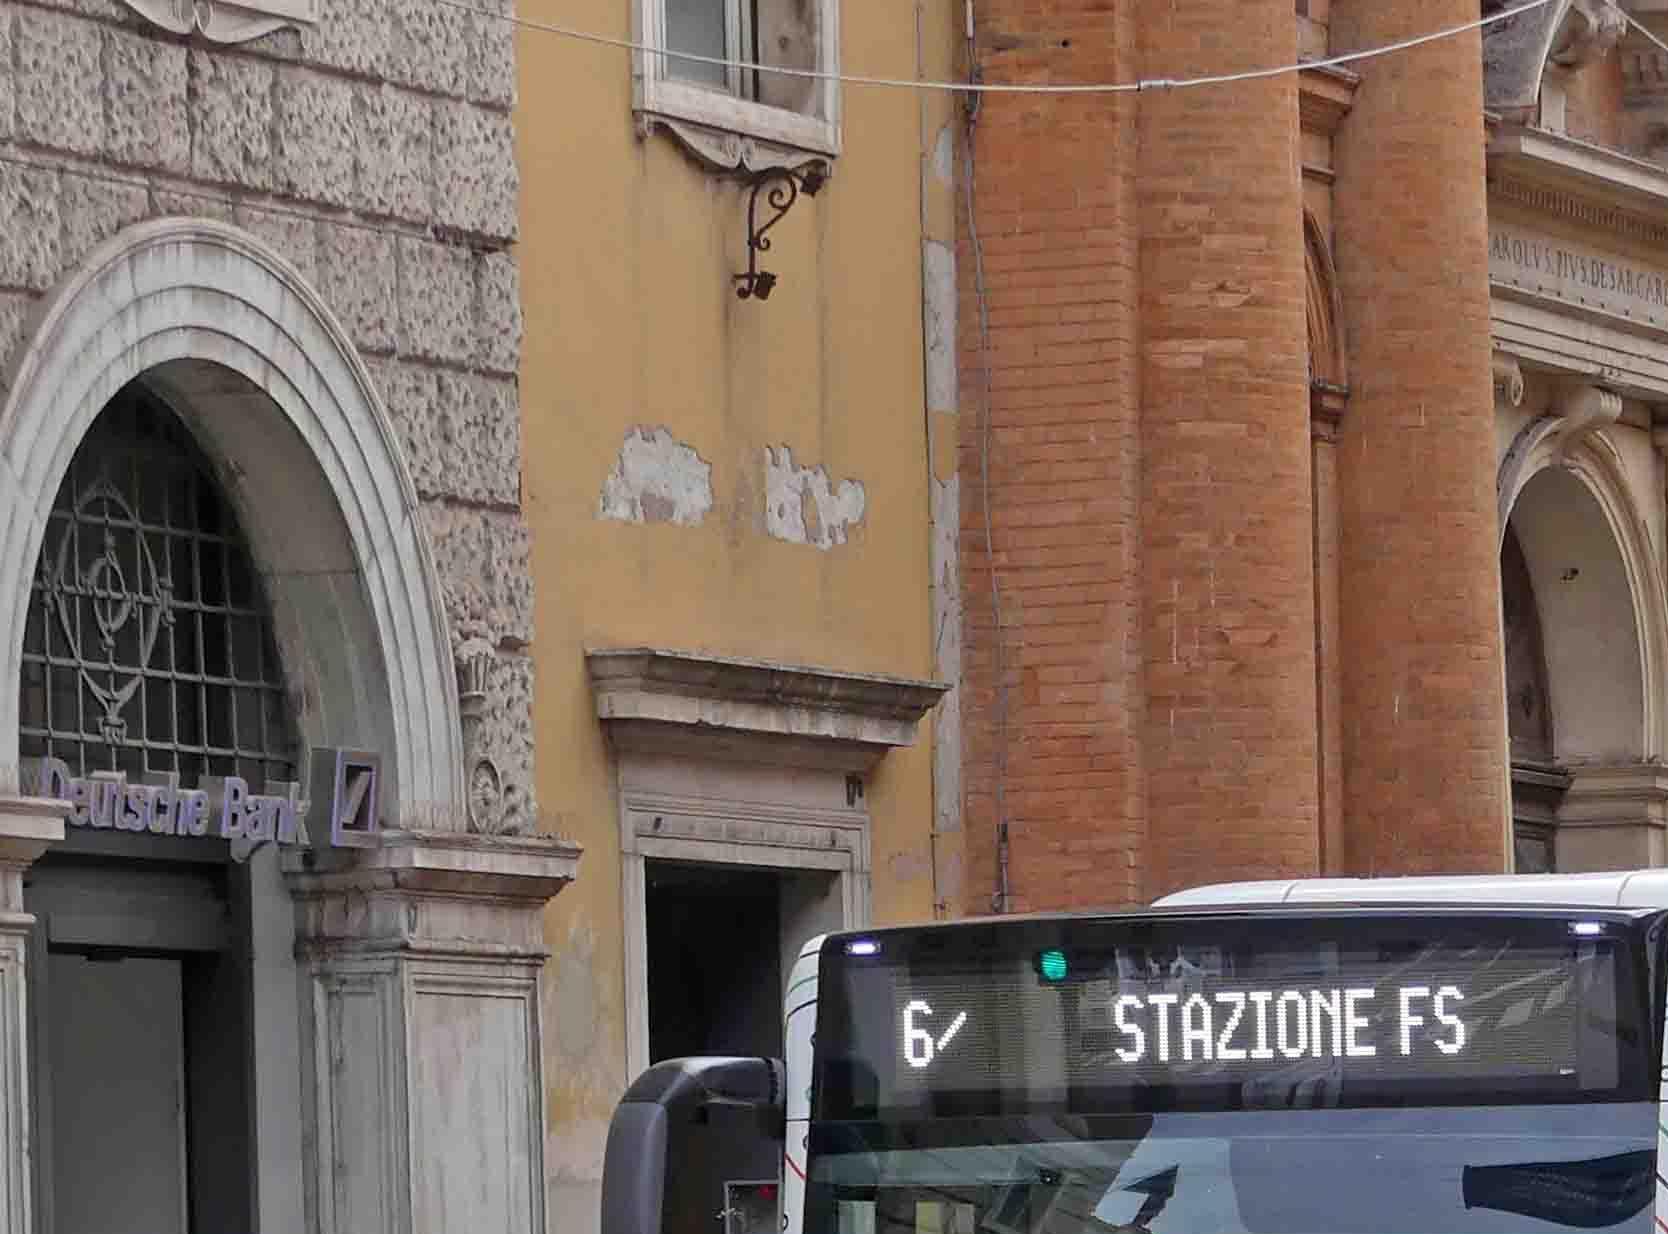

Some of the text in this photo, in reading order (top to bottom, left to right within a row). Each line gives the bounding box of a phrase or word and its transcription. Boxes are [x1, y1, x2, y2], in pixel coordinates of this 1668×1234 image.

[43, 757, 310, 846] Deutsche Bank
[1113, 988, 1376, 1061] STAZIONE
[1399, 985, 1466, 1054] FS
